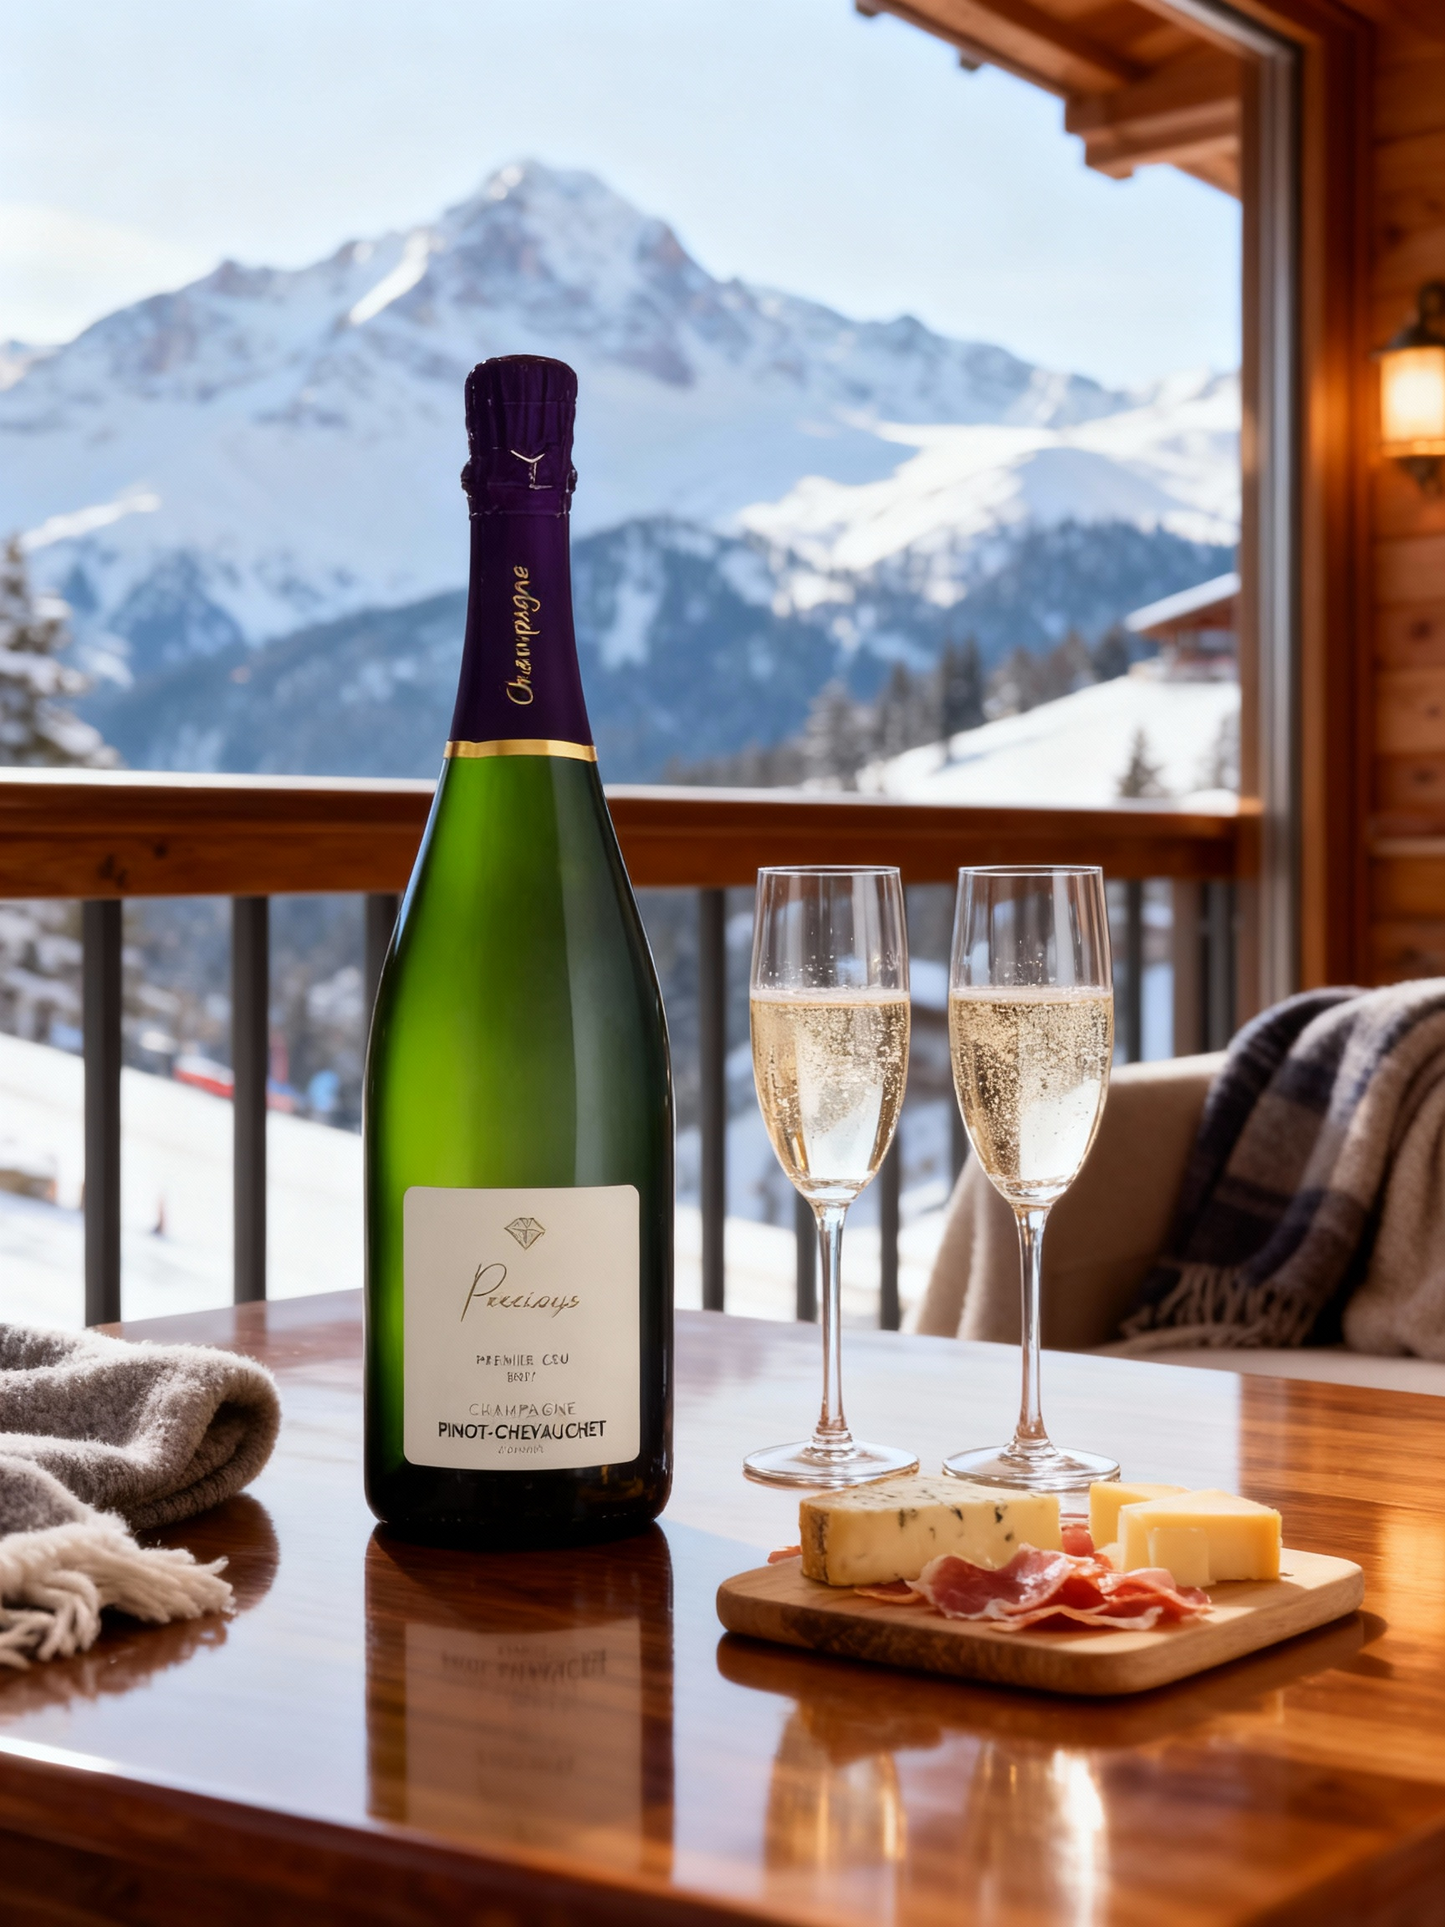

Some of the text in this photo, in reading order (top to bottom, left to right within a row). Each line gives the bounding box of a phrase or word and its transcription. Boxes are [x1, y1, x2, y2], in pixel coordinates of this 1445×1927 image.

[506, 565, 541, 706] Champagne
[469, 1402, 577, 1418] CHAMPAGNE
[438, 1420, 607, 1440] PINOT-CHEVAUCHET
